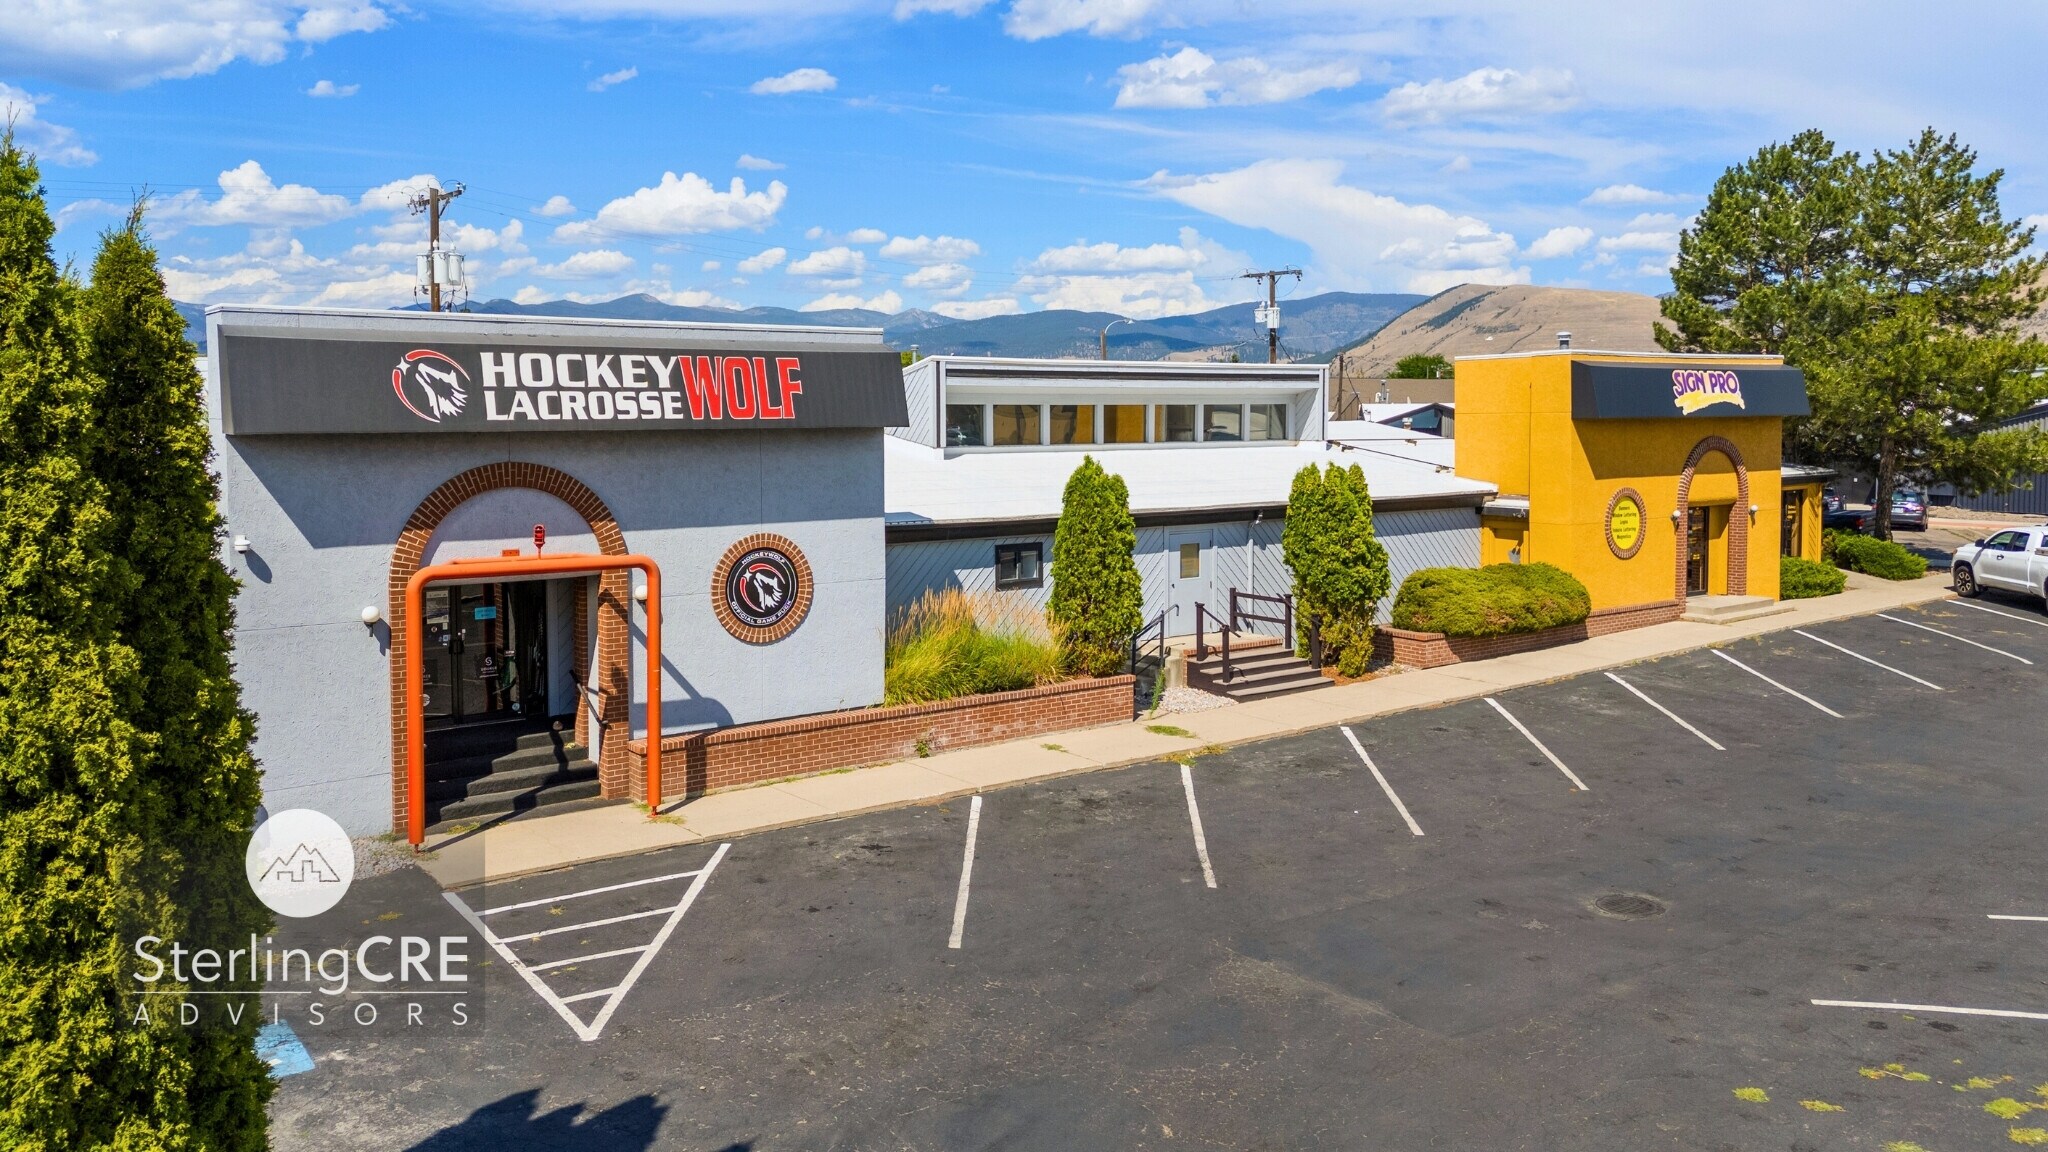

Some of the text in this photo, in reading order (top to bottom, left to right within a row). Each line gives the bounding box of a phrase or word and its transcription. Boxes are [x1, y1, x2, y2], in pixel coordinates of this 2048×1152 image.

[479, 352, 802, 420] HOCKEY WOLF
[1673, 371, 1738, 397] SIGN PRO
[483, 390, 684, 421] LACROSSE
[741, 551, 786, 565] HOCKEYWOLF
[731, 601, 755, 624] OFFICIAL
[756, 616, 777, 624] GAME
